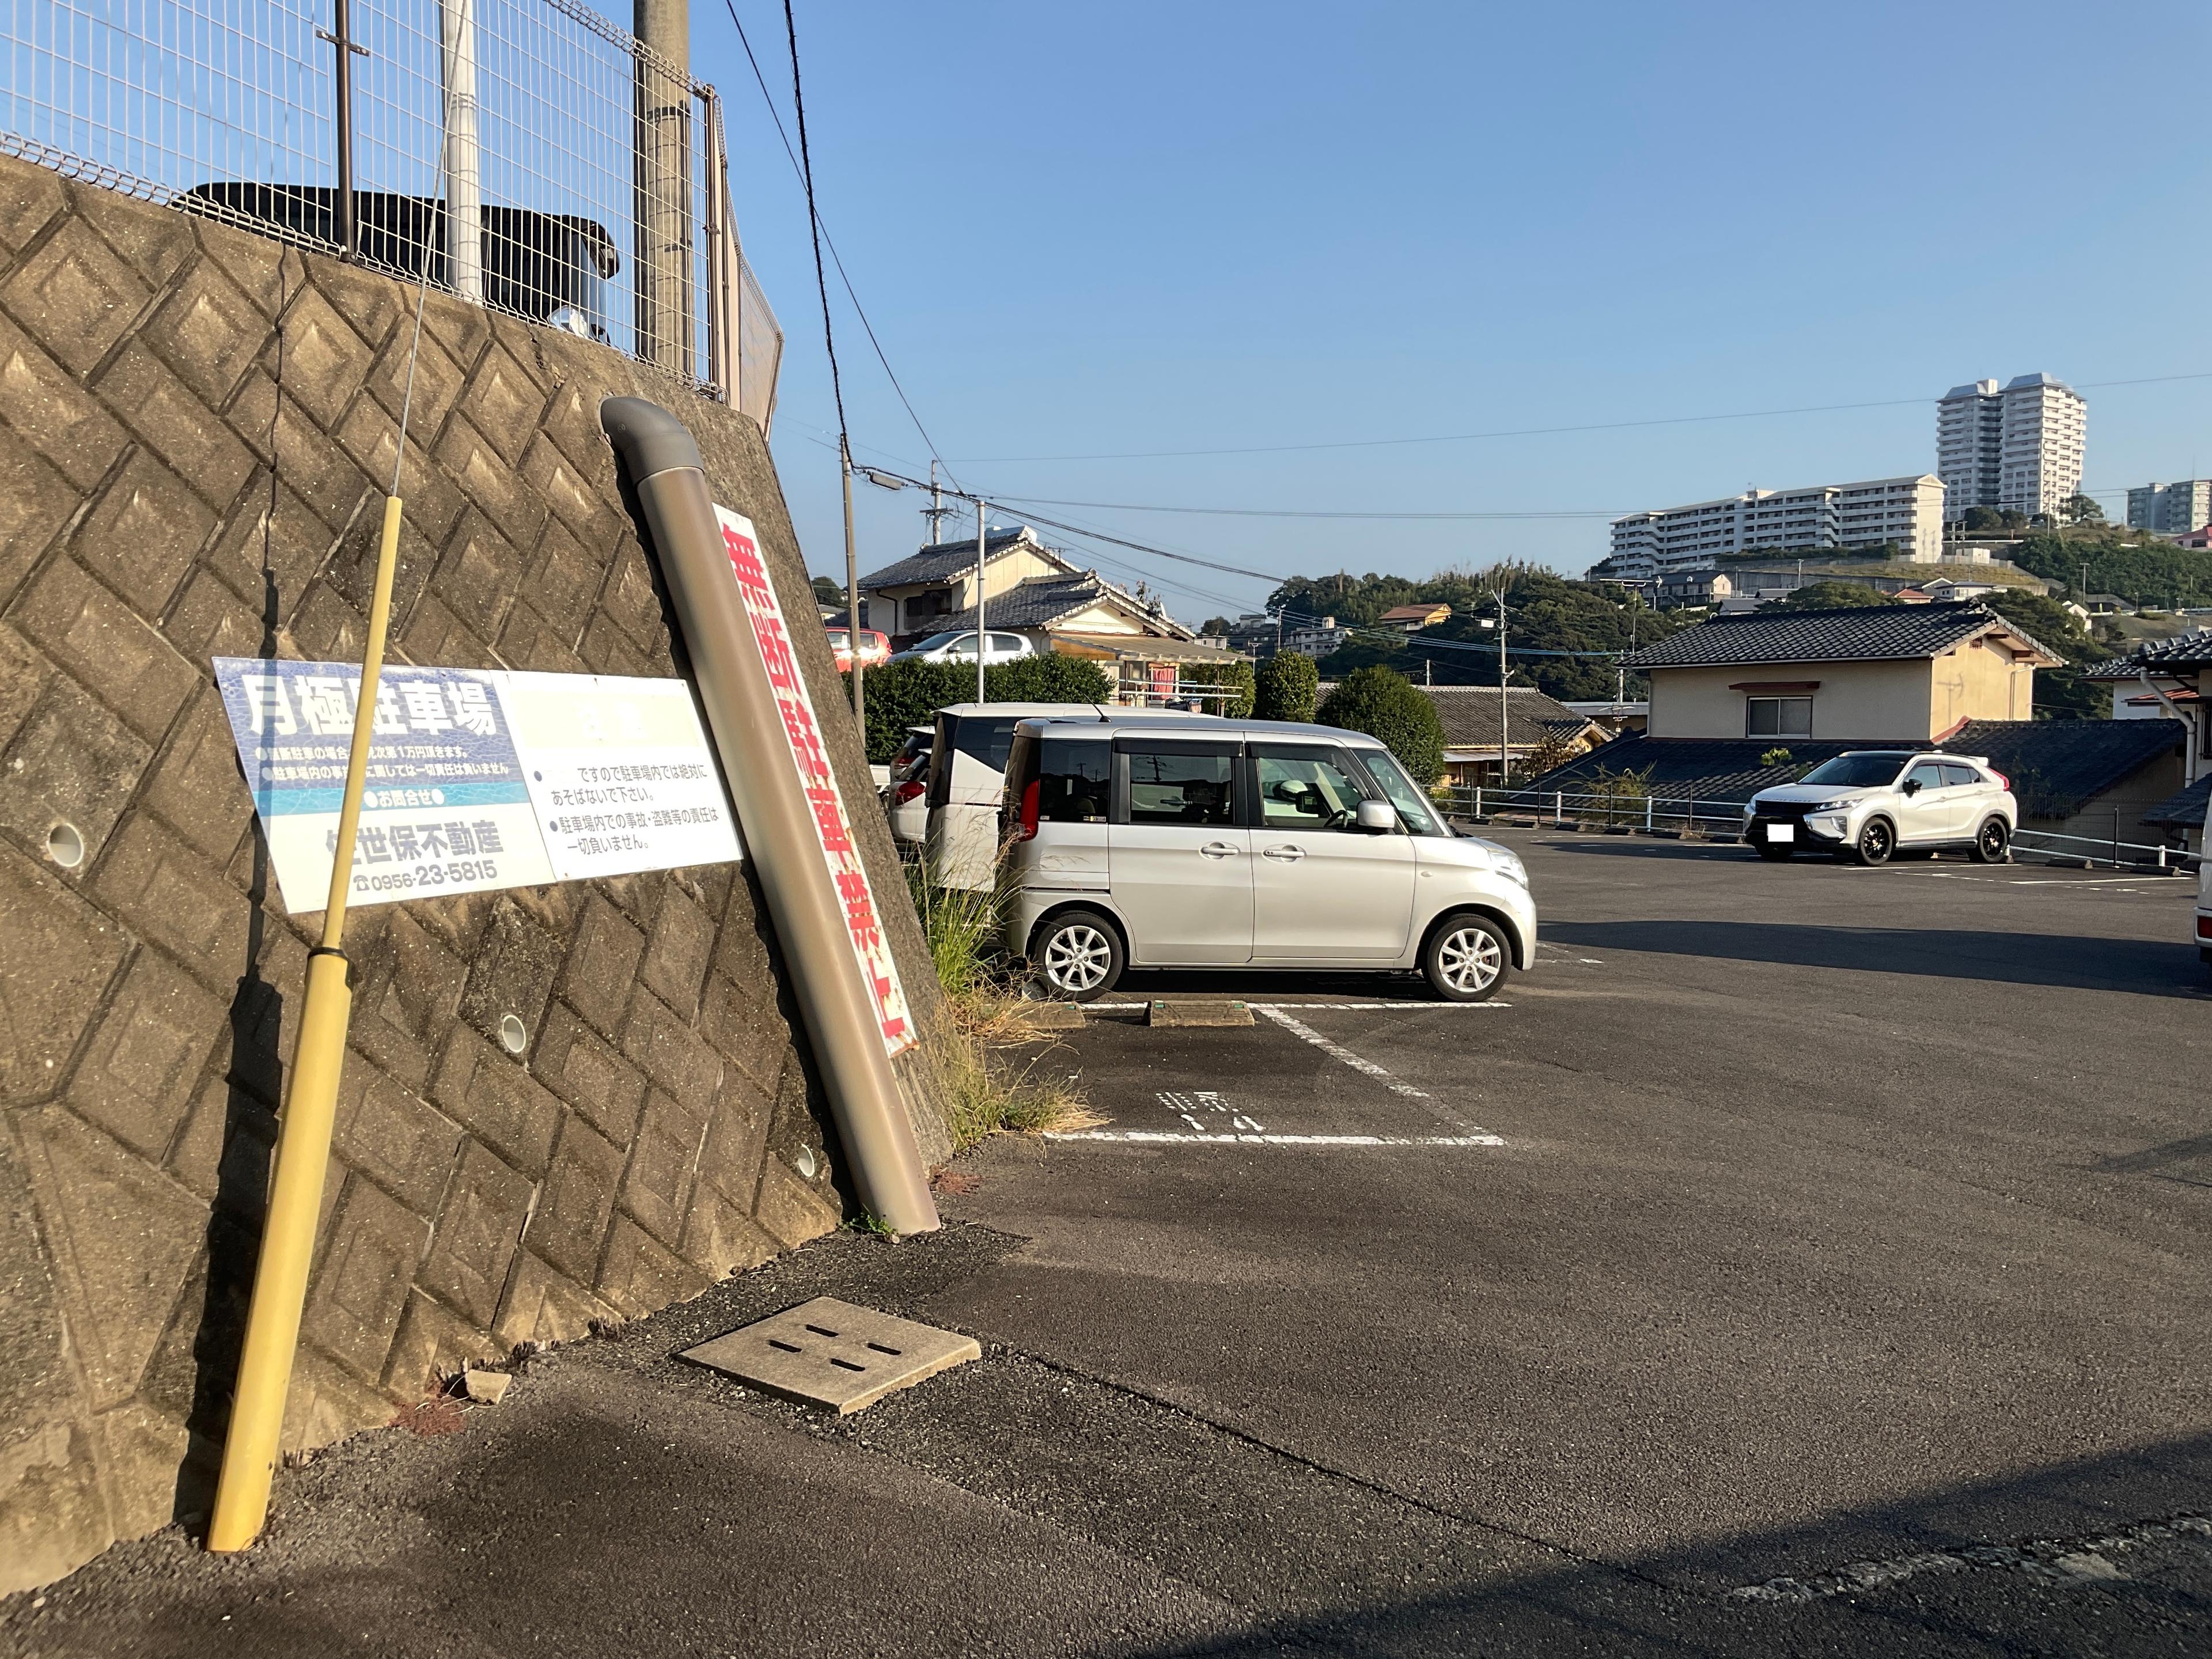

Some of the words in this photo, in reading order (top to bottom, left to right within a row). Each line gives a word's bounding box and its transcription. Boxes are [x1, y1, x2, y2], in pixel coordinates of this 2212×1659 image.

[577, 764, 707, 782] ですので駐車場内では絶対に
[377, 789, 433, 808] お問合せ
[551, 786, 654, 806] あそばないで下さい。
[559, 807, 719, 834] 駐車場内での事故・盗難等の責任は
[567, 834, 649, 855] 一切負いません。
